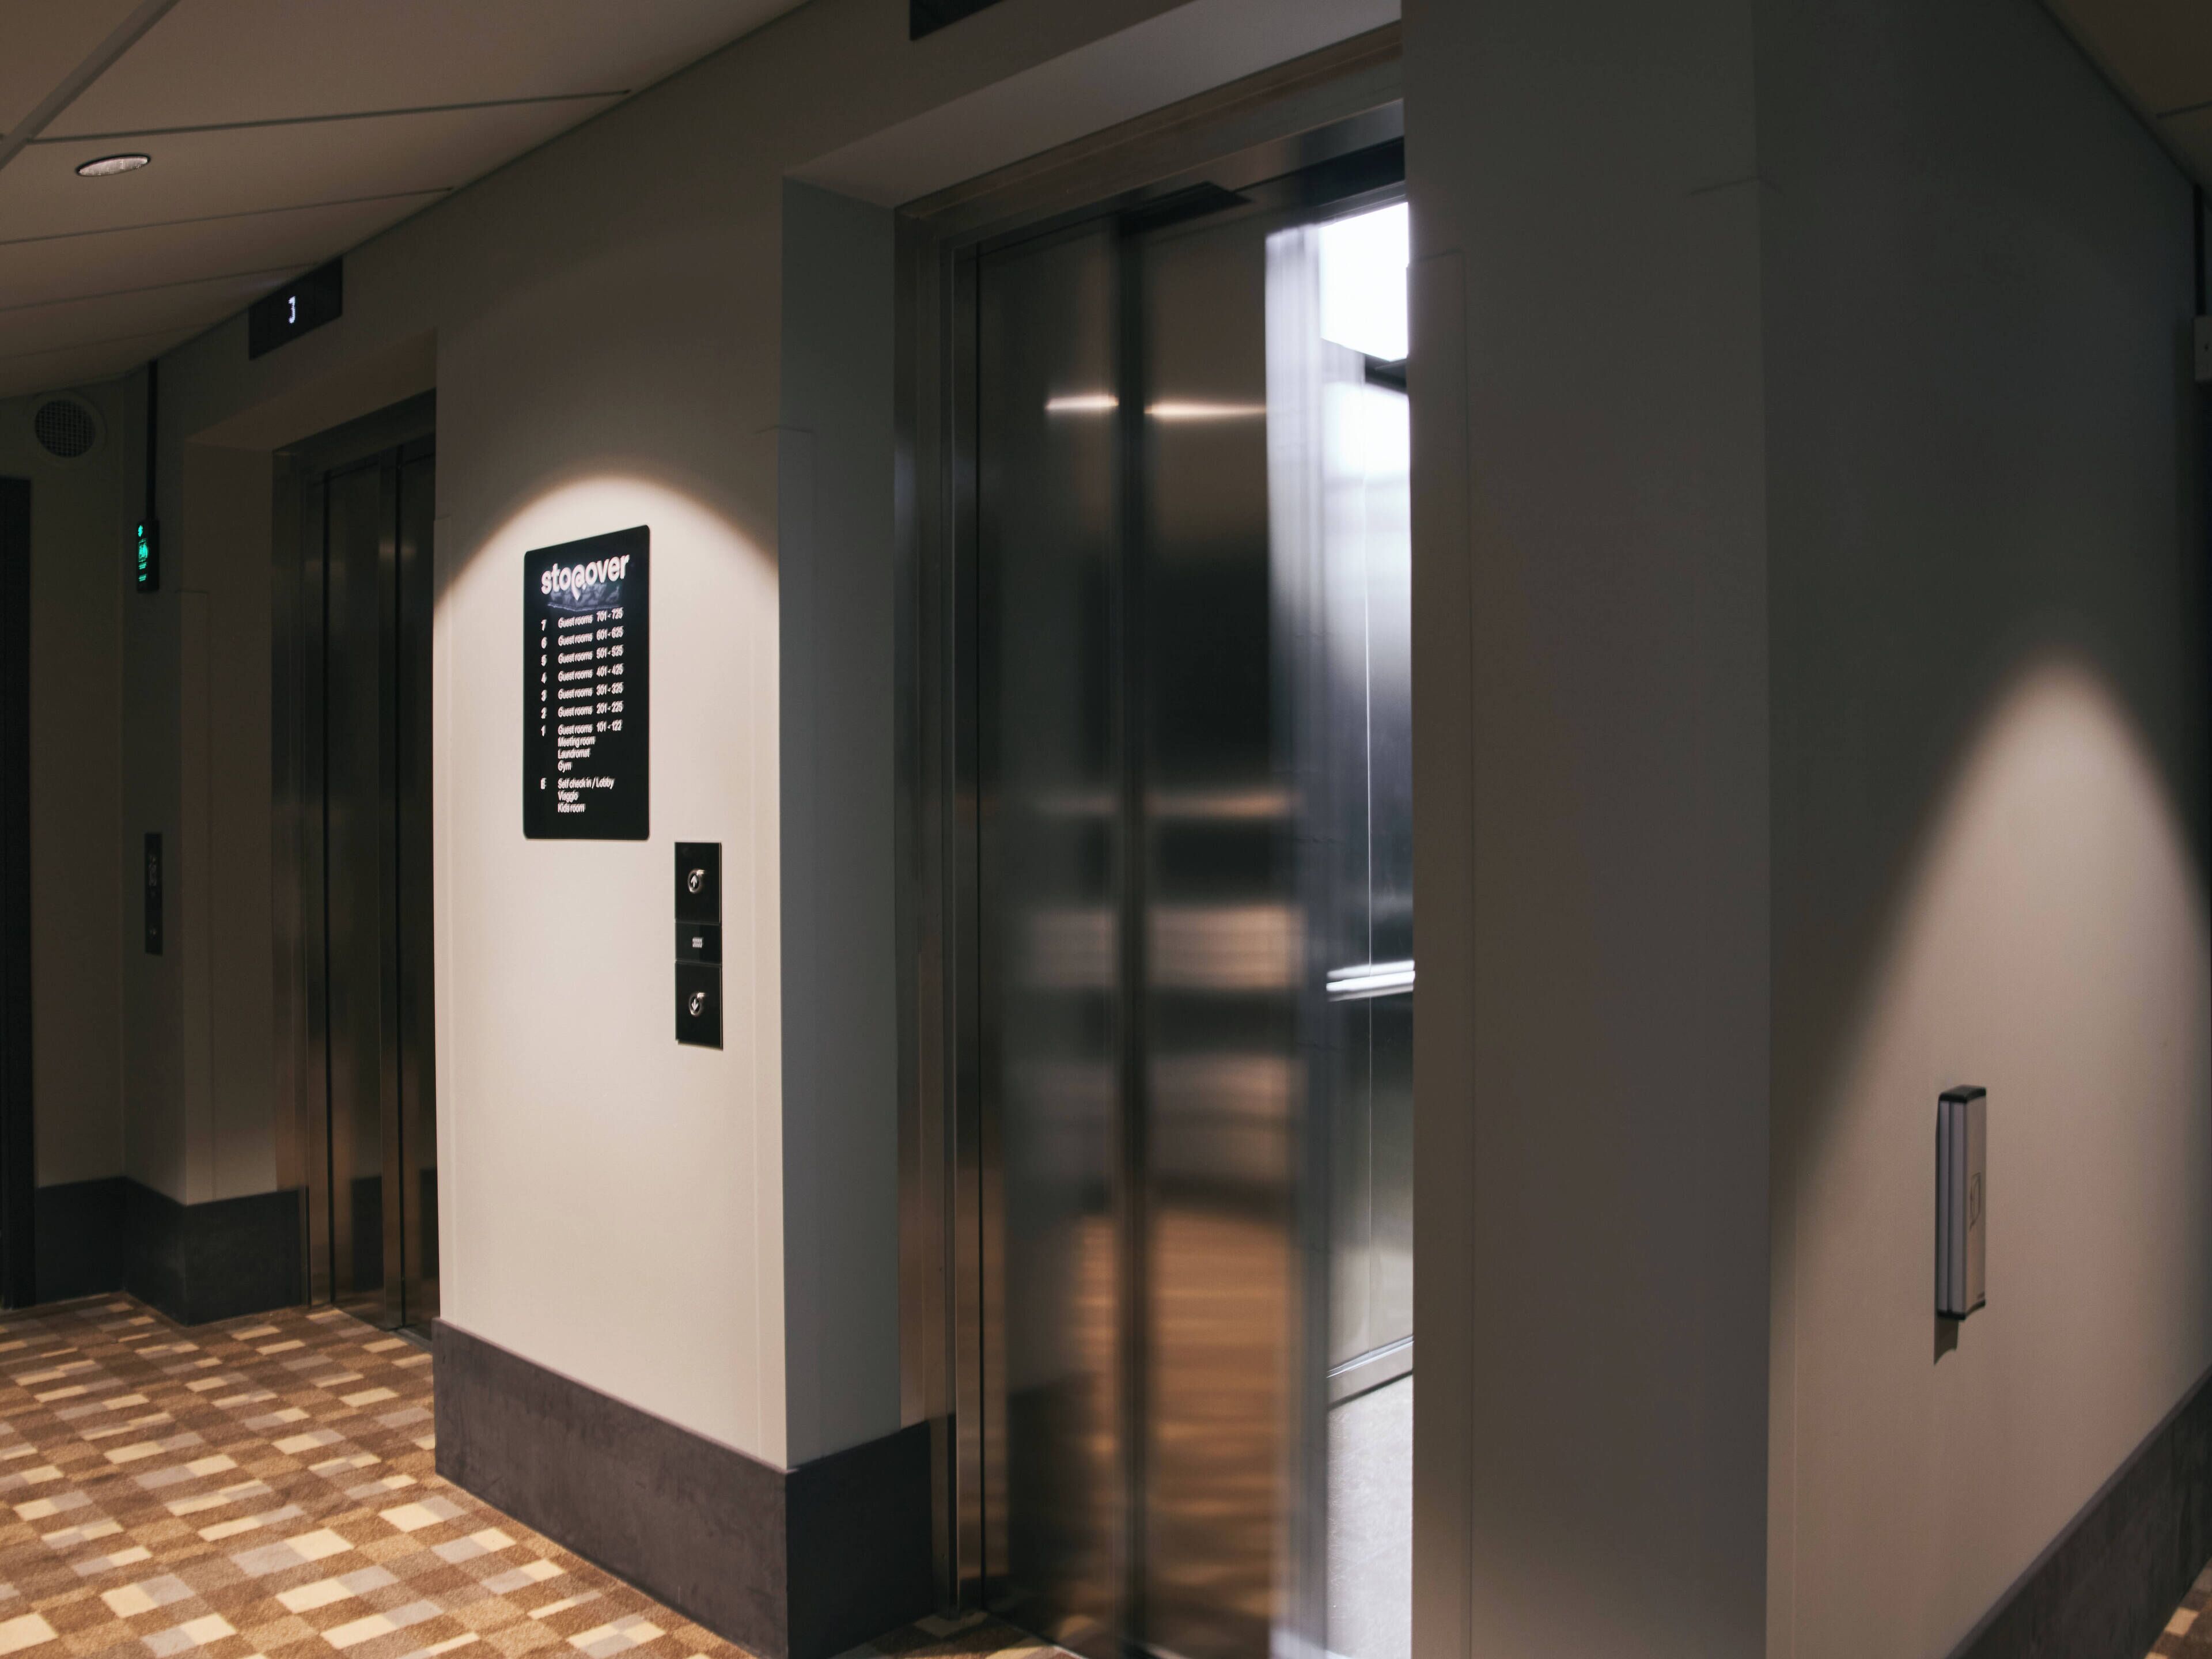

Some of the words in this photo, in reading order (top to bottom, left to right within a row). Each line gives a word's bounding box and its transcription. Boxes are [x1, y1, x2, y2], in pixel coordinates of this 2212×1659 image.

[541, 637, 547, 649] 6
[541, 654, 547, 666] 5
[541, 672, 547, 683] 4
[541, 690, 547, 702] 3
[541, 707, 547, 719] 2
[541, 725, 546, 736] 1
[558, 760, 572, 773] Gym
